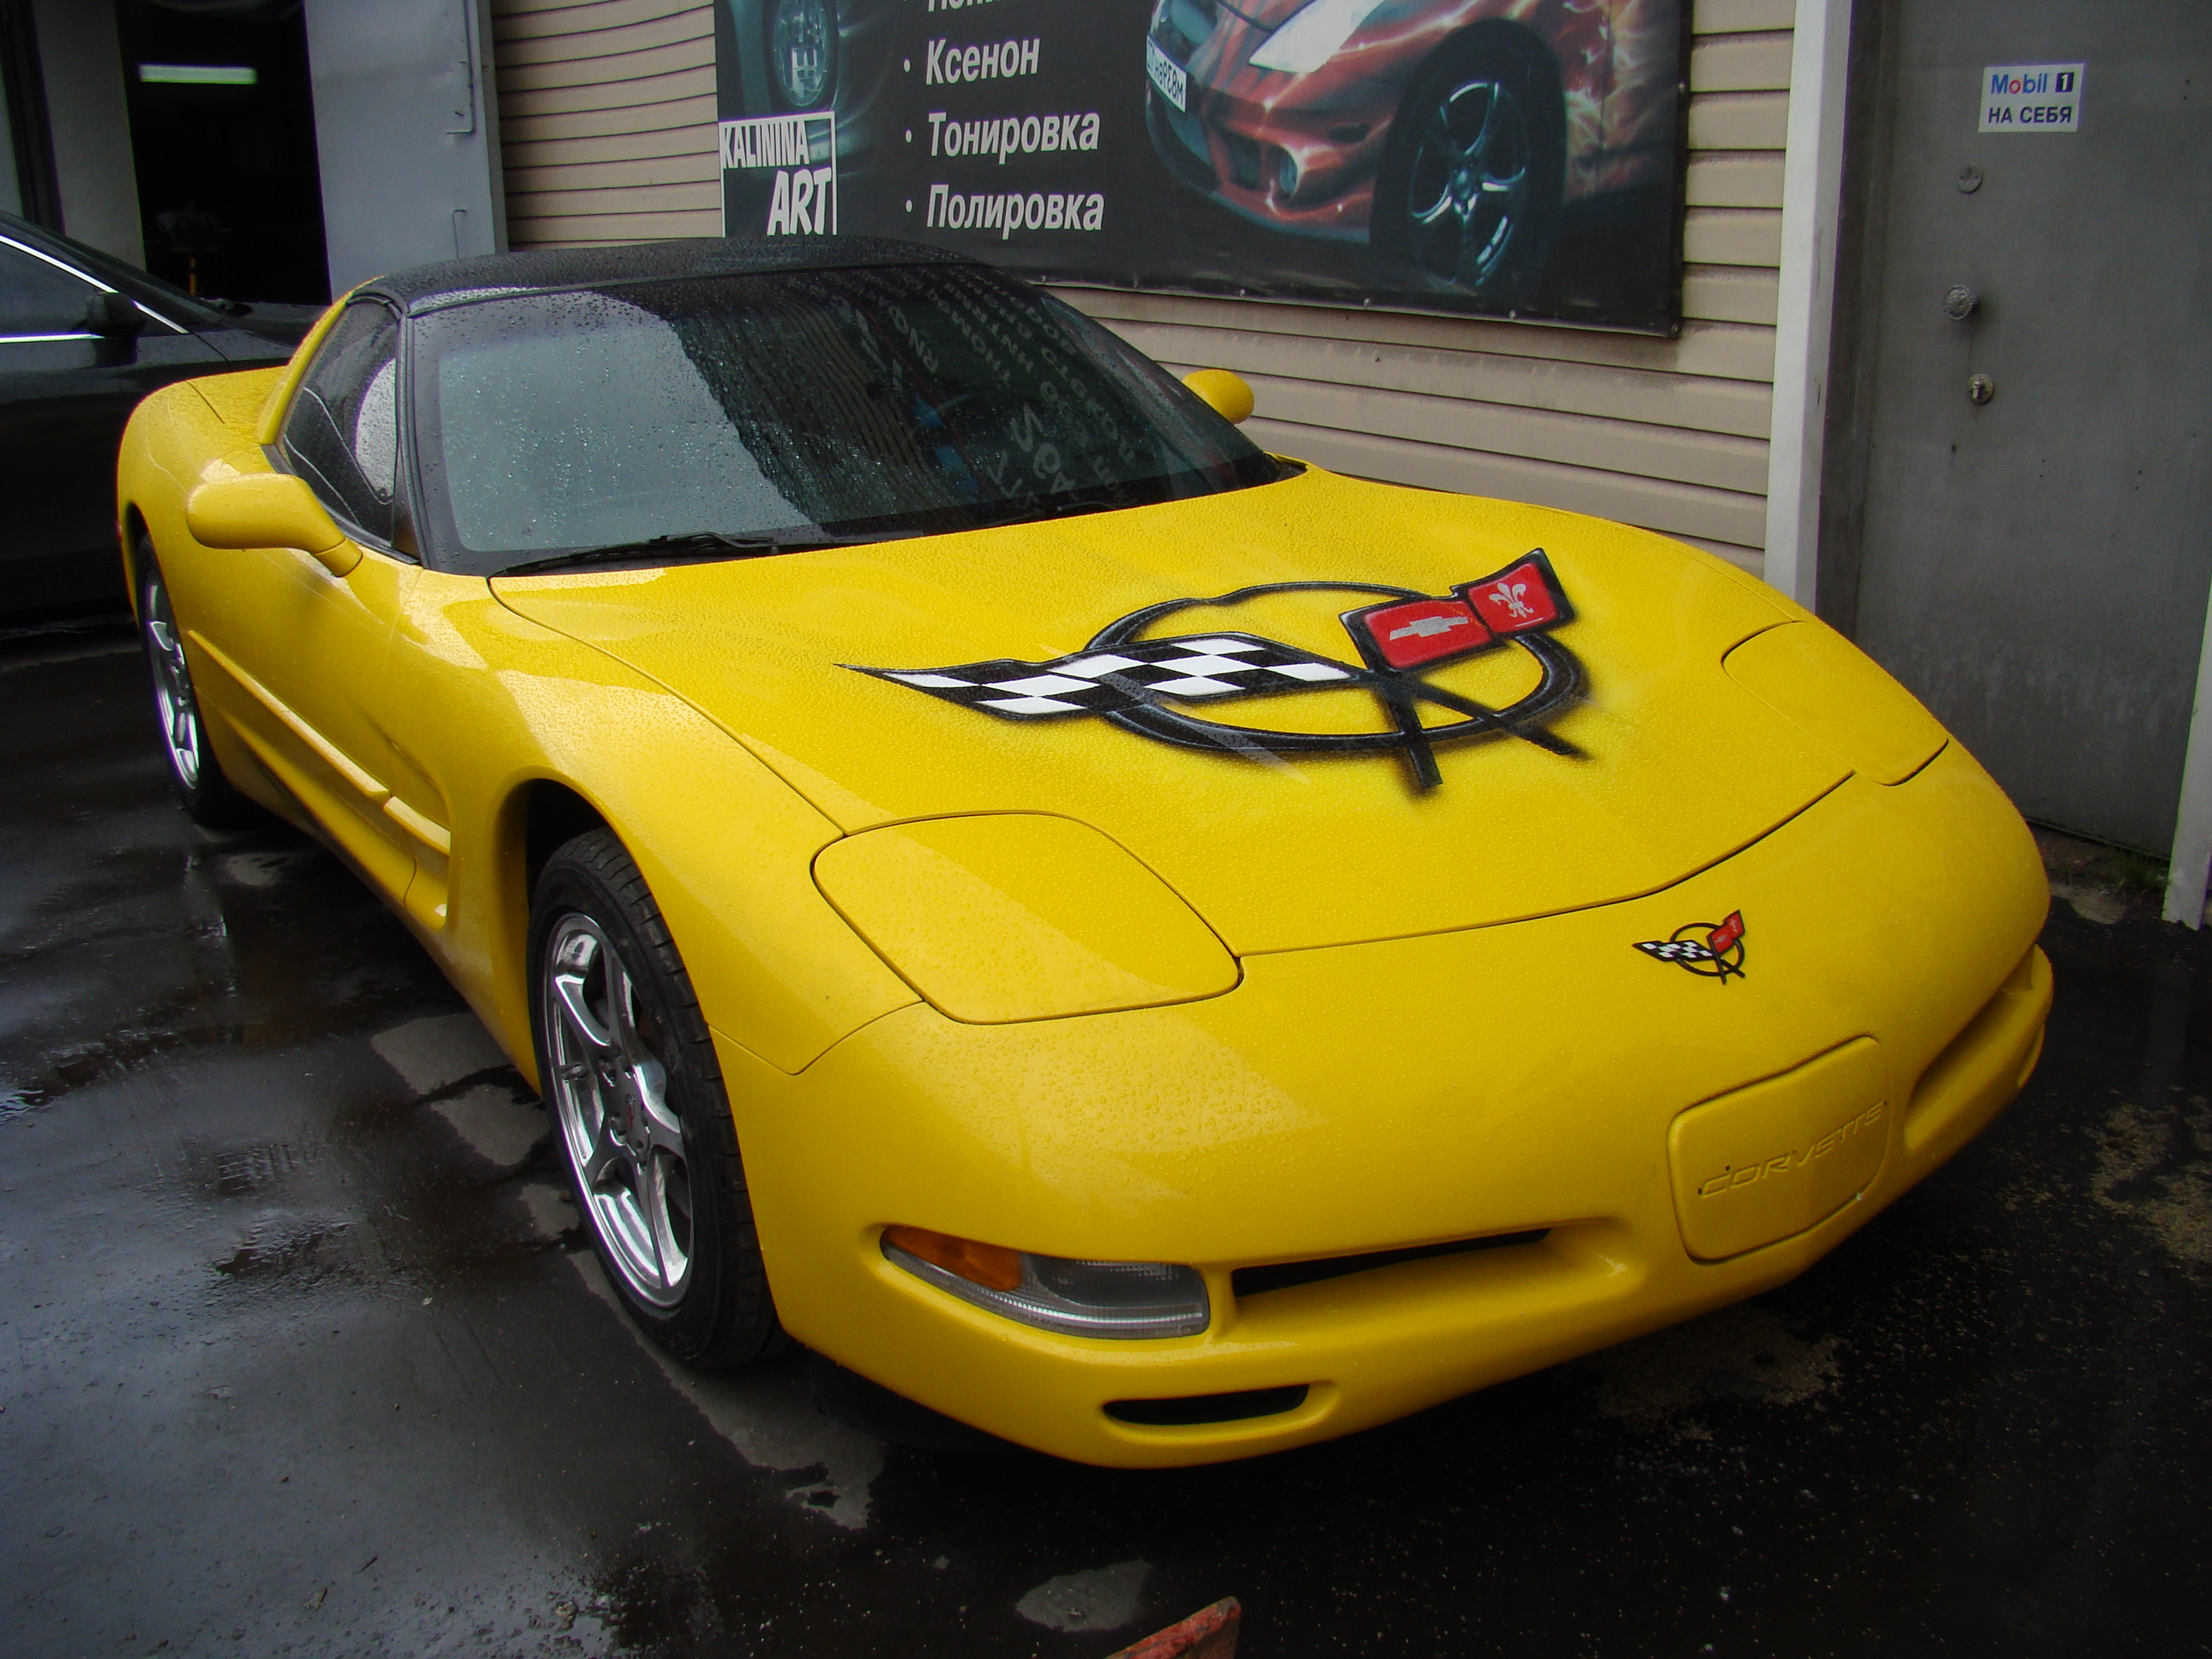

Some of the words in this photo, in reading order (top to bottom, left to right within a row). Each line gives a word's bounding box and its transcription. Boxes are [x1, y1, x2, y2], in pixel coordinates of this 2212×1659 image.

[926, 38, 1040, 85] Ксенон
[1990, 73, 2048, 94] Mobil
[927, 112, 1101, 165] Тонировка
[1988, 106, 2013, 123] НА
[2019, 106, 2072, 124] СЕБЯ
[719, 120, 811, 169] KALININA
[766, 167, 832, 236] ART
[927, 184, 1105, 240] Полировка
[1700, 1100, 1884, 1199] CORVETTE
